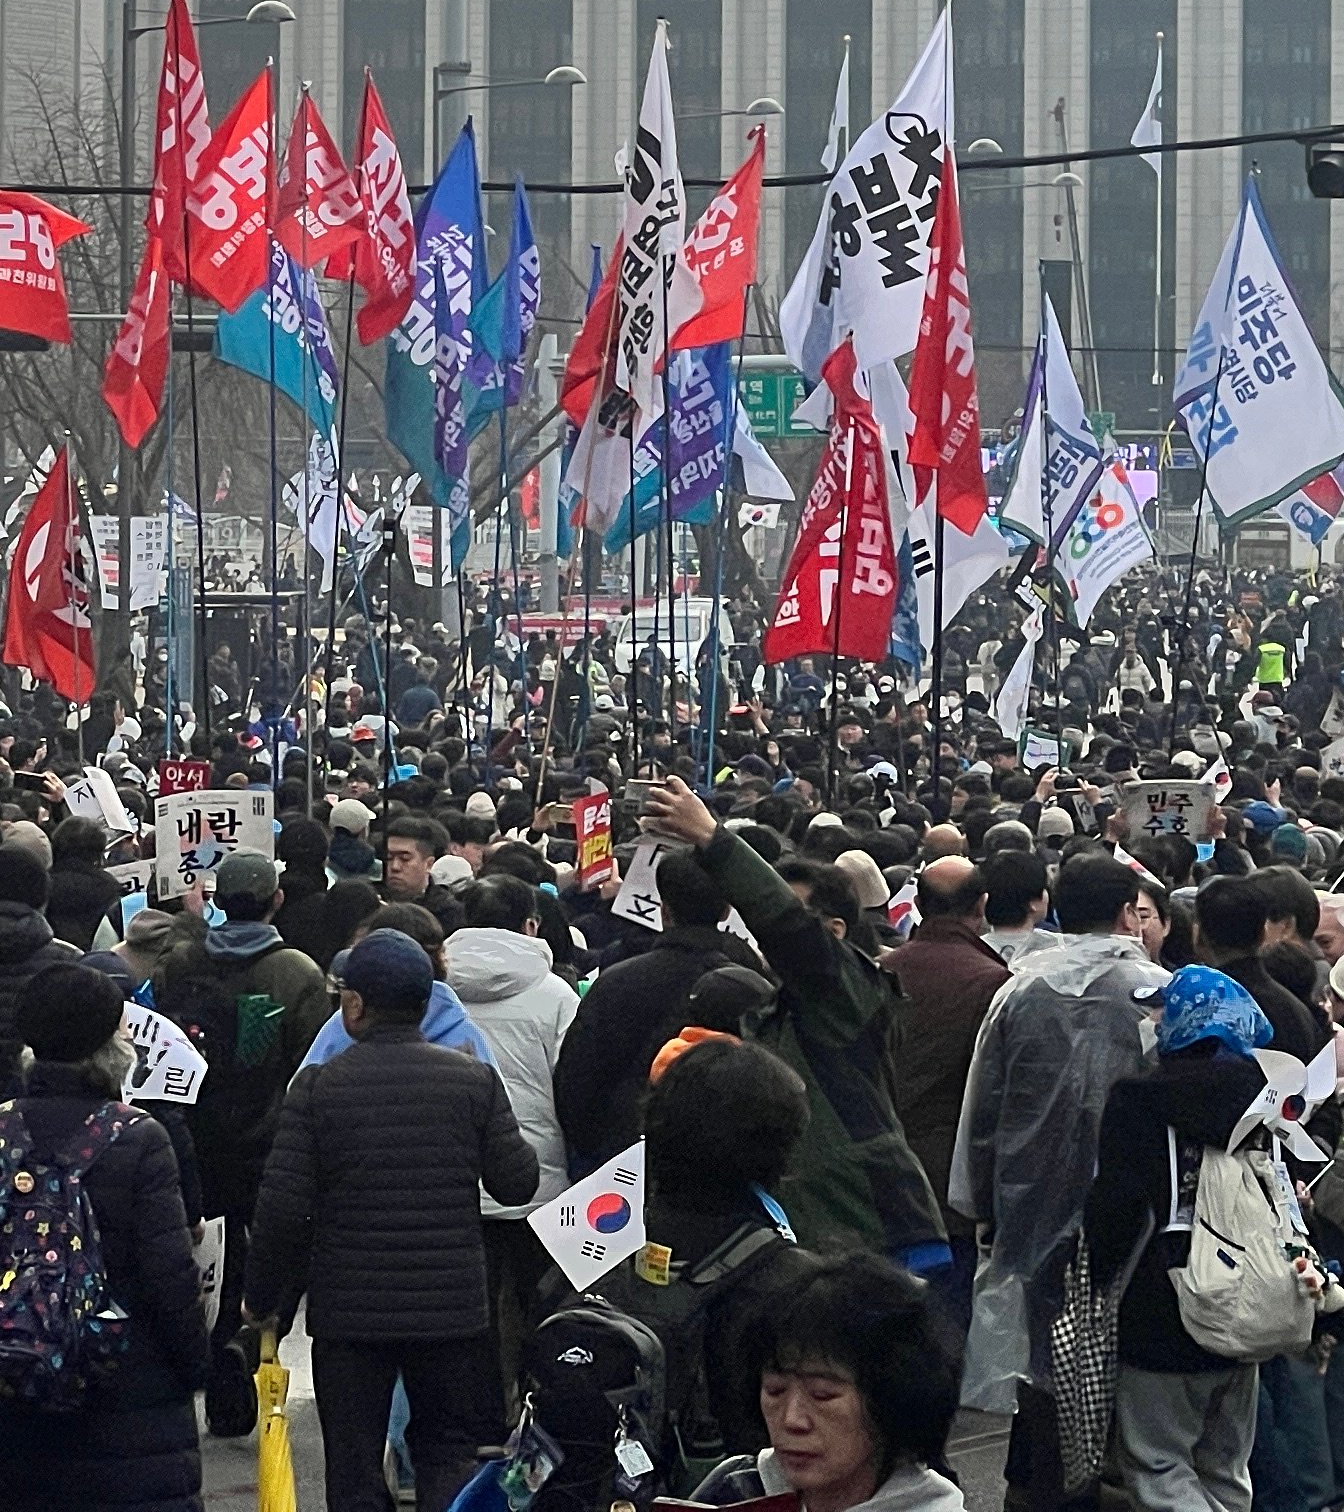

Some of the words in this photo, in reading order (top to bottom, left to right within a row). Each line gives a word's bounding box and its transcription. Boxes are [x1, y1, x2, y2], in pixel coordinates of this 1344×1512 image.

[165, 766, 204, 791] 안성
[1146, 790, 1194, 815] 민주
[176, 808, 243, 845] 내란
[1142, 815, 1191, 837] 수호
